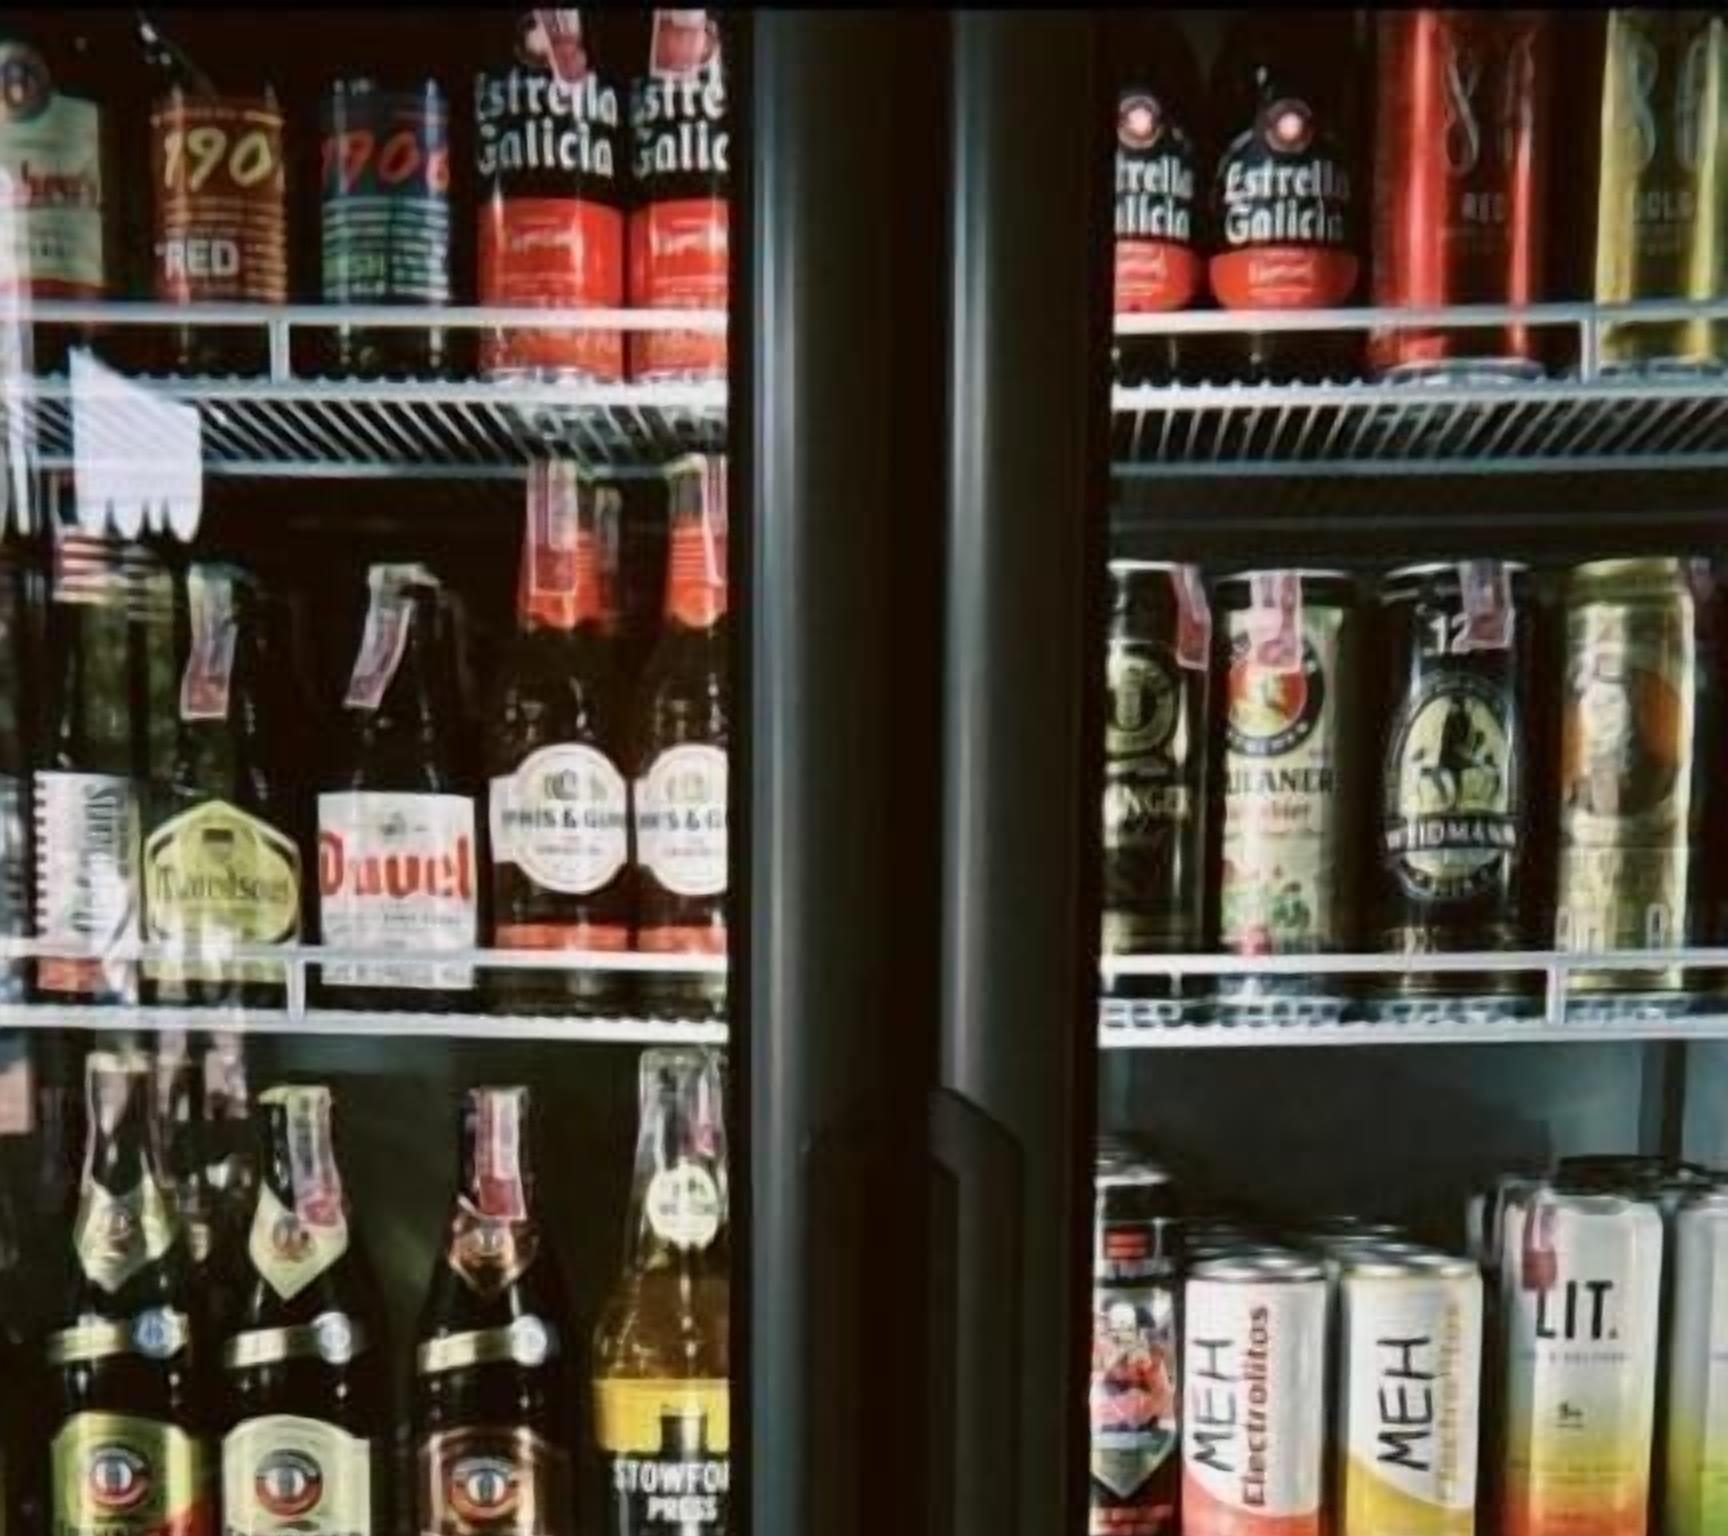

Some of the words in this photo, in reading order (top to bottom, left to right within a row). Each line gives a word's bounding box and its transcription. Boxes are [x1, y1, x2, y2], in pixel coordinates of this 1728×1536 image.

[631, 68, 729, 126] Estre
[163, 128, 284, 194] 190
[632, 120, 729, 178] Galic
[1116, 151, 1192, 199] trella
[318, 830, 471, 902] Duvel
[1192, 1336, 1238, 1473] MEH
[1242, 1304, 1269, 1505] Electrolitos
[1376, 1335, 1434, 1473] MEH
[647, 1495, 719, 1523] PRESS
